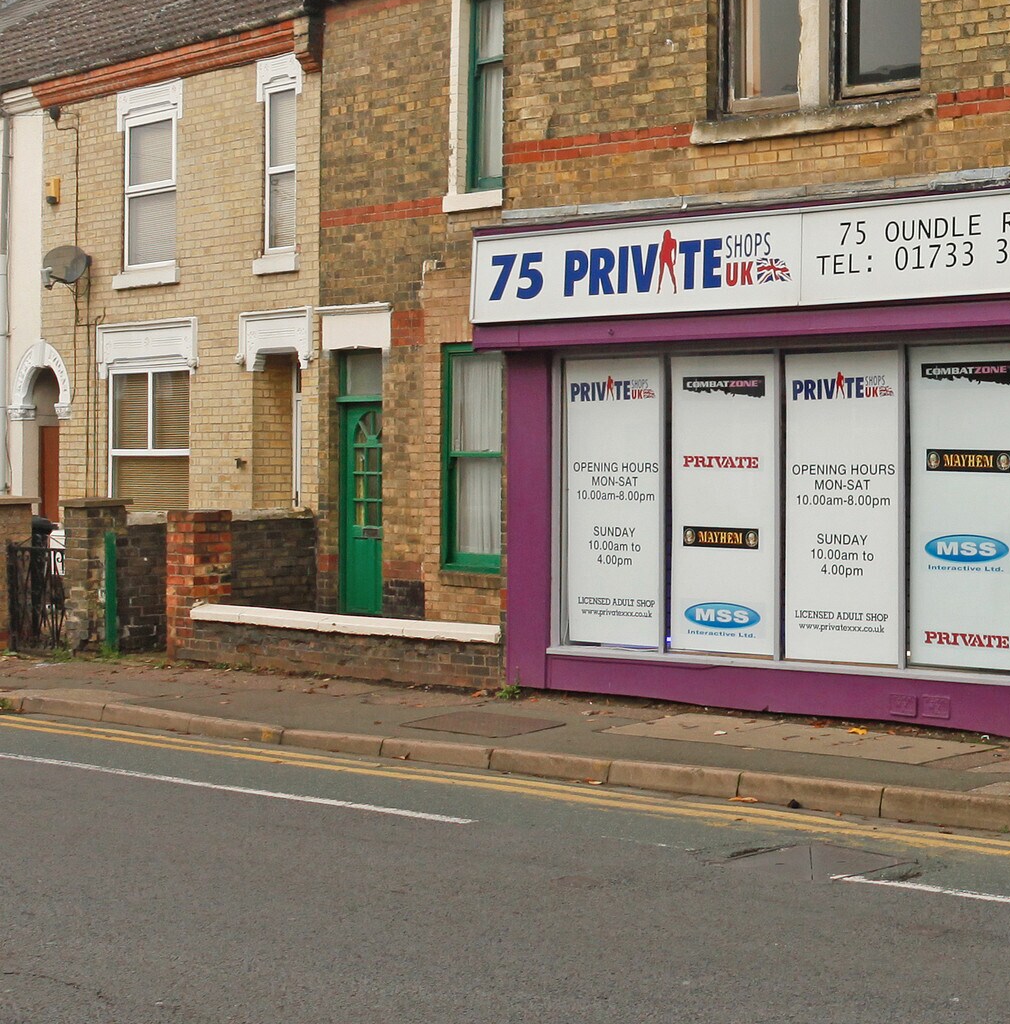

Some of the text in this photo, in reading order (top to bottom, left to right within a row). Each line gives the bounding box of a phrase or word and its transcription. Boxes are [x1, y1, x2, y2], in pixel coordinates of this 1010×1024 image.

[839, 221, 867, 246] 75
[885, 214, 982, 242] OUNDLE
[488, 229, 771, 301] 75 PRIVATE SHOPS UK
[817, 253, 874, 276] TEL:
[895, 241, 974, 271] 01733
[570, 376, 631, 402] PRIVATE
[632, 389, 643, 400] UK
[792, 371, 886, 401] PRIVATE SHOPS UK
[573, 462, 659, 473] OPENING HOURS
[683, 455, 759, 469] PRIVATE
[943, 454, 994, 468] MAYHEM
[792, 464, 896, 475] OPENING HOURS
[592, 476, 638, 487] MON-SAT
[814, 479, 870, 490] MON-SAT
[577, 490, 655, 503] 10.00am-8.00pm
[796, 494, 891, 507] 10.00am-8.00pm
[593, 526, 635, 537] SUNDAY
[698, 530, 743, 544] MAYHEM
[817, 533, 868, 545] SUNDAY
[589, 540, 641, 552] 10.00am to
[937, 540, 997, 557] MSS
[597, 554, 632, 567] 4.00pm
[811, 548, 874, 561] 10.00am to
[821, 564, 864, 578] 4.00pm
[928, 564, 981, 572] Interactive
[578, 596, 656, 608] LICENSED ADULT SHOP
[695, 607, 749, 624] MSS
[794, 610, 889, 622] LICENSED ADULT SHOP
[687, 629, 756, 639] Interactive Ltd.
[924, 631, 1010, 649] PRIVATE
